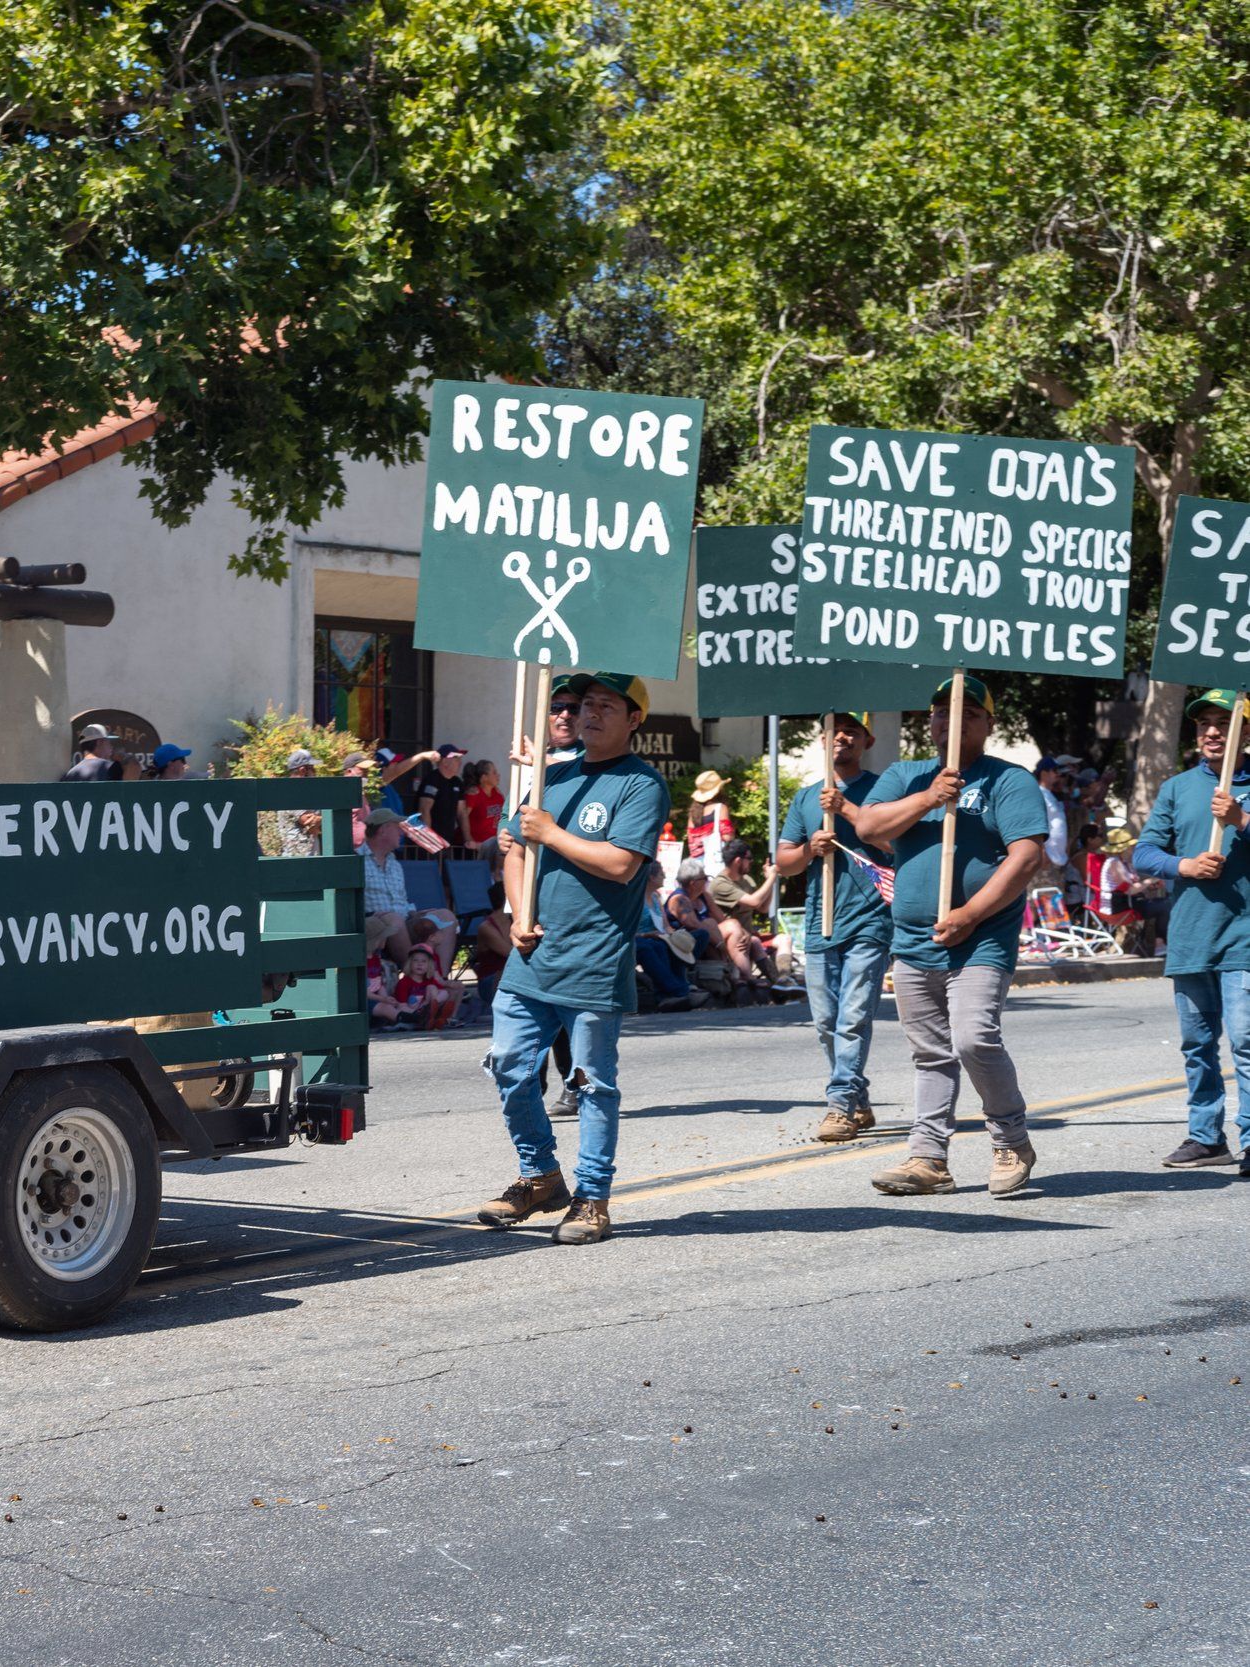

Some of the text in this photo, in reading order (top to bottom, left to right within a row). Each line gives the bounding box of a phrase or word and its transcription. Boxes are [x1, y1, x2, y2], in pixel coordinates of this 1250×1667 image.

[452, 393, 693, 477] RESTORE
[827, 436, 1117, 507] SAVE OJAI'S
[432, 481, 671, 556] MATILIJA
[771, 533, 802, 575] S
[804, 496, 1133, 573] THREATENED SPECIES
[801, 542, 1129, 616] STEELHEAD TROUT
[1218, 572, 1250, 606] T
[820, 601, 1117, 667] POND TURTLES
[630, 732, 674, 755] OJAI
